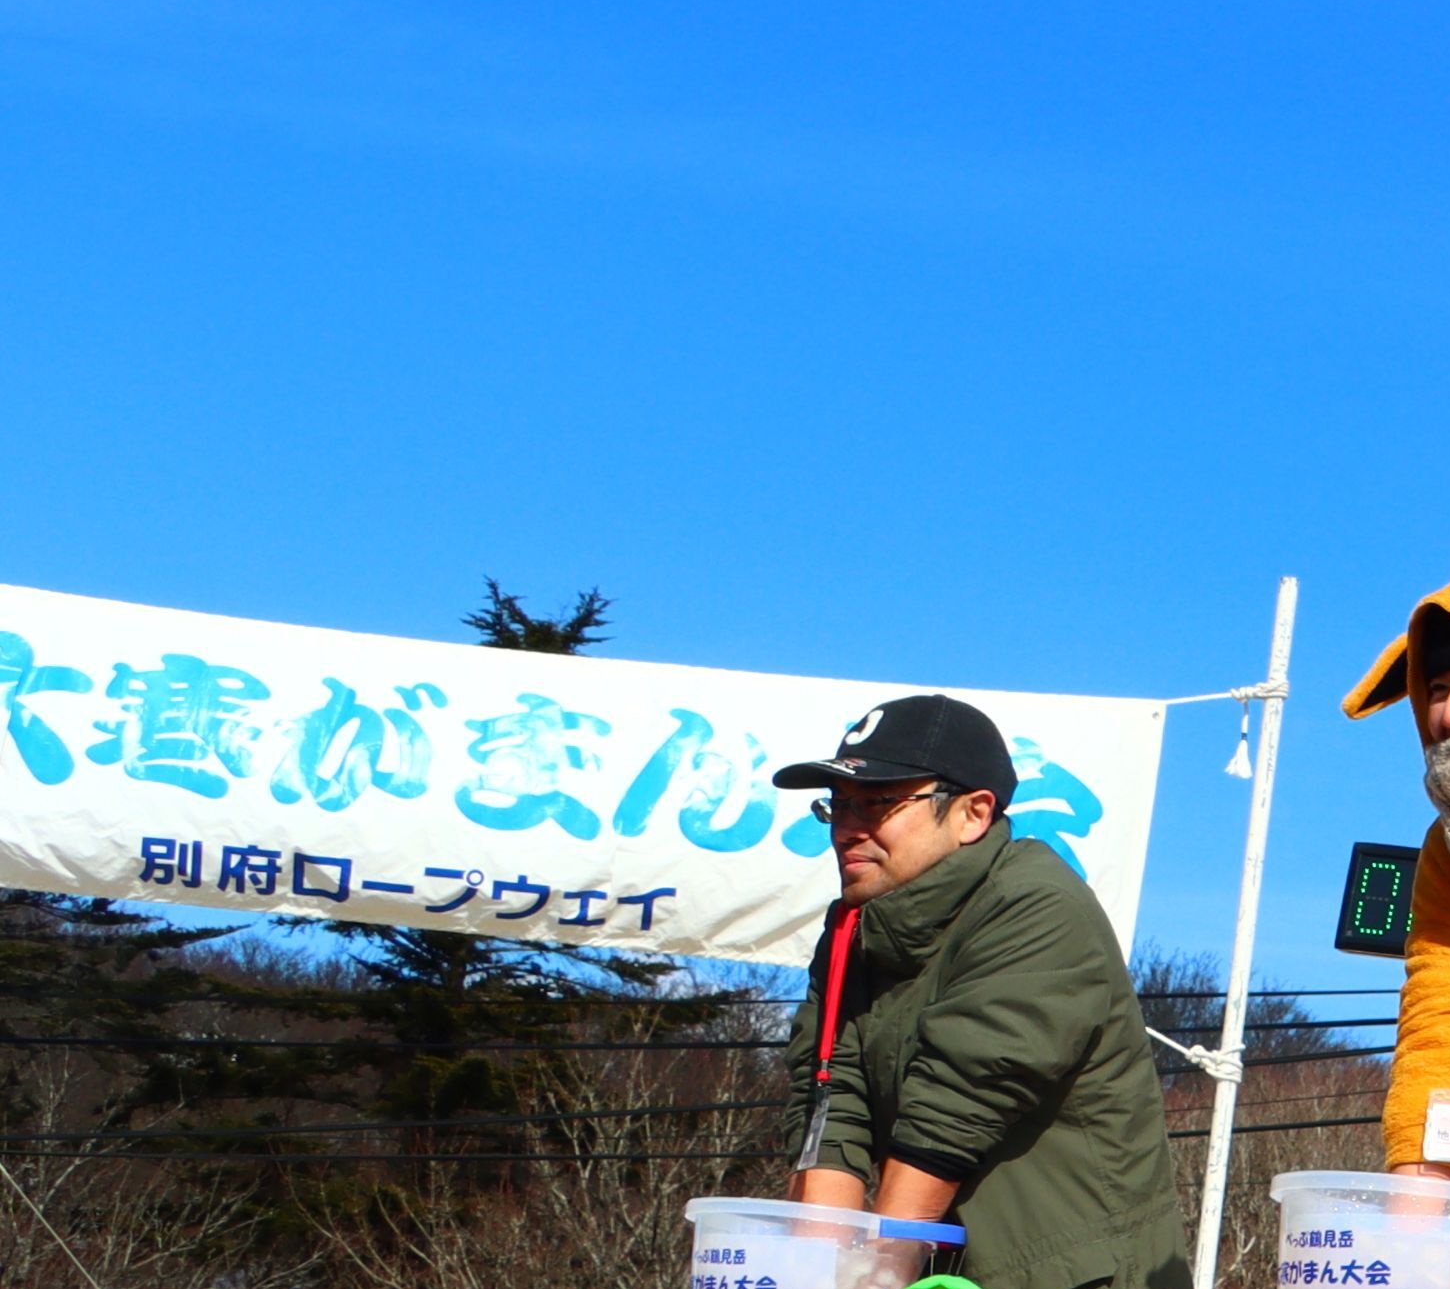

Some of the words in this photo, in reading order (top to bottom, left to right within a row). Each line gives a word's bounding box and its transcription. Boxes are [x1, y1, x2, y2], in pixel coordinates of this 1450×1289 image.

[139, 836, 677, 931] 別府ロープウェイ
